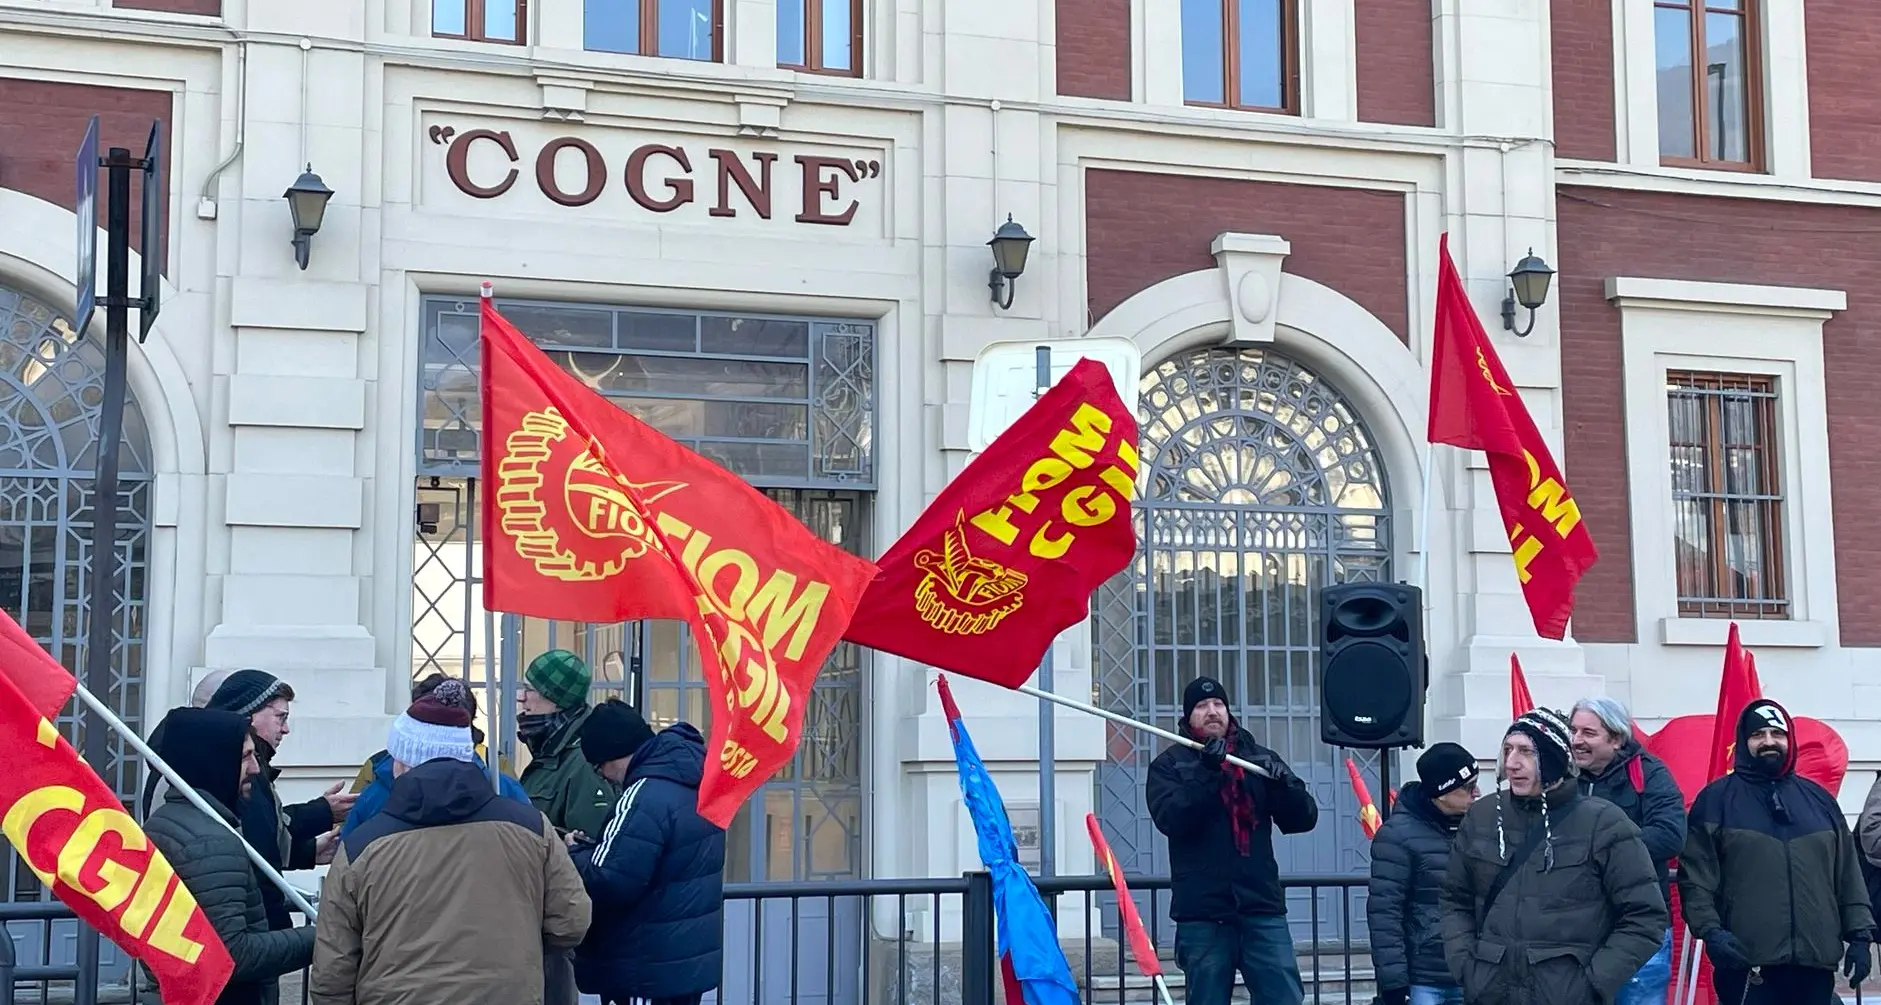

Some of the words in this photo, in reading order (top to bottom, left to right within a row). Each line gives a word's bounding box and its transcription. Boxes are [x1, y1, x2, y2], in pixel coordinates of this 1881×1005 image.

[970, 402, 1113, 547] FIOM
[720, 739, 759, 780] OSTA
[1, 785, 205, 965] CGIL
